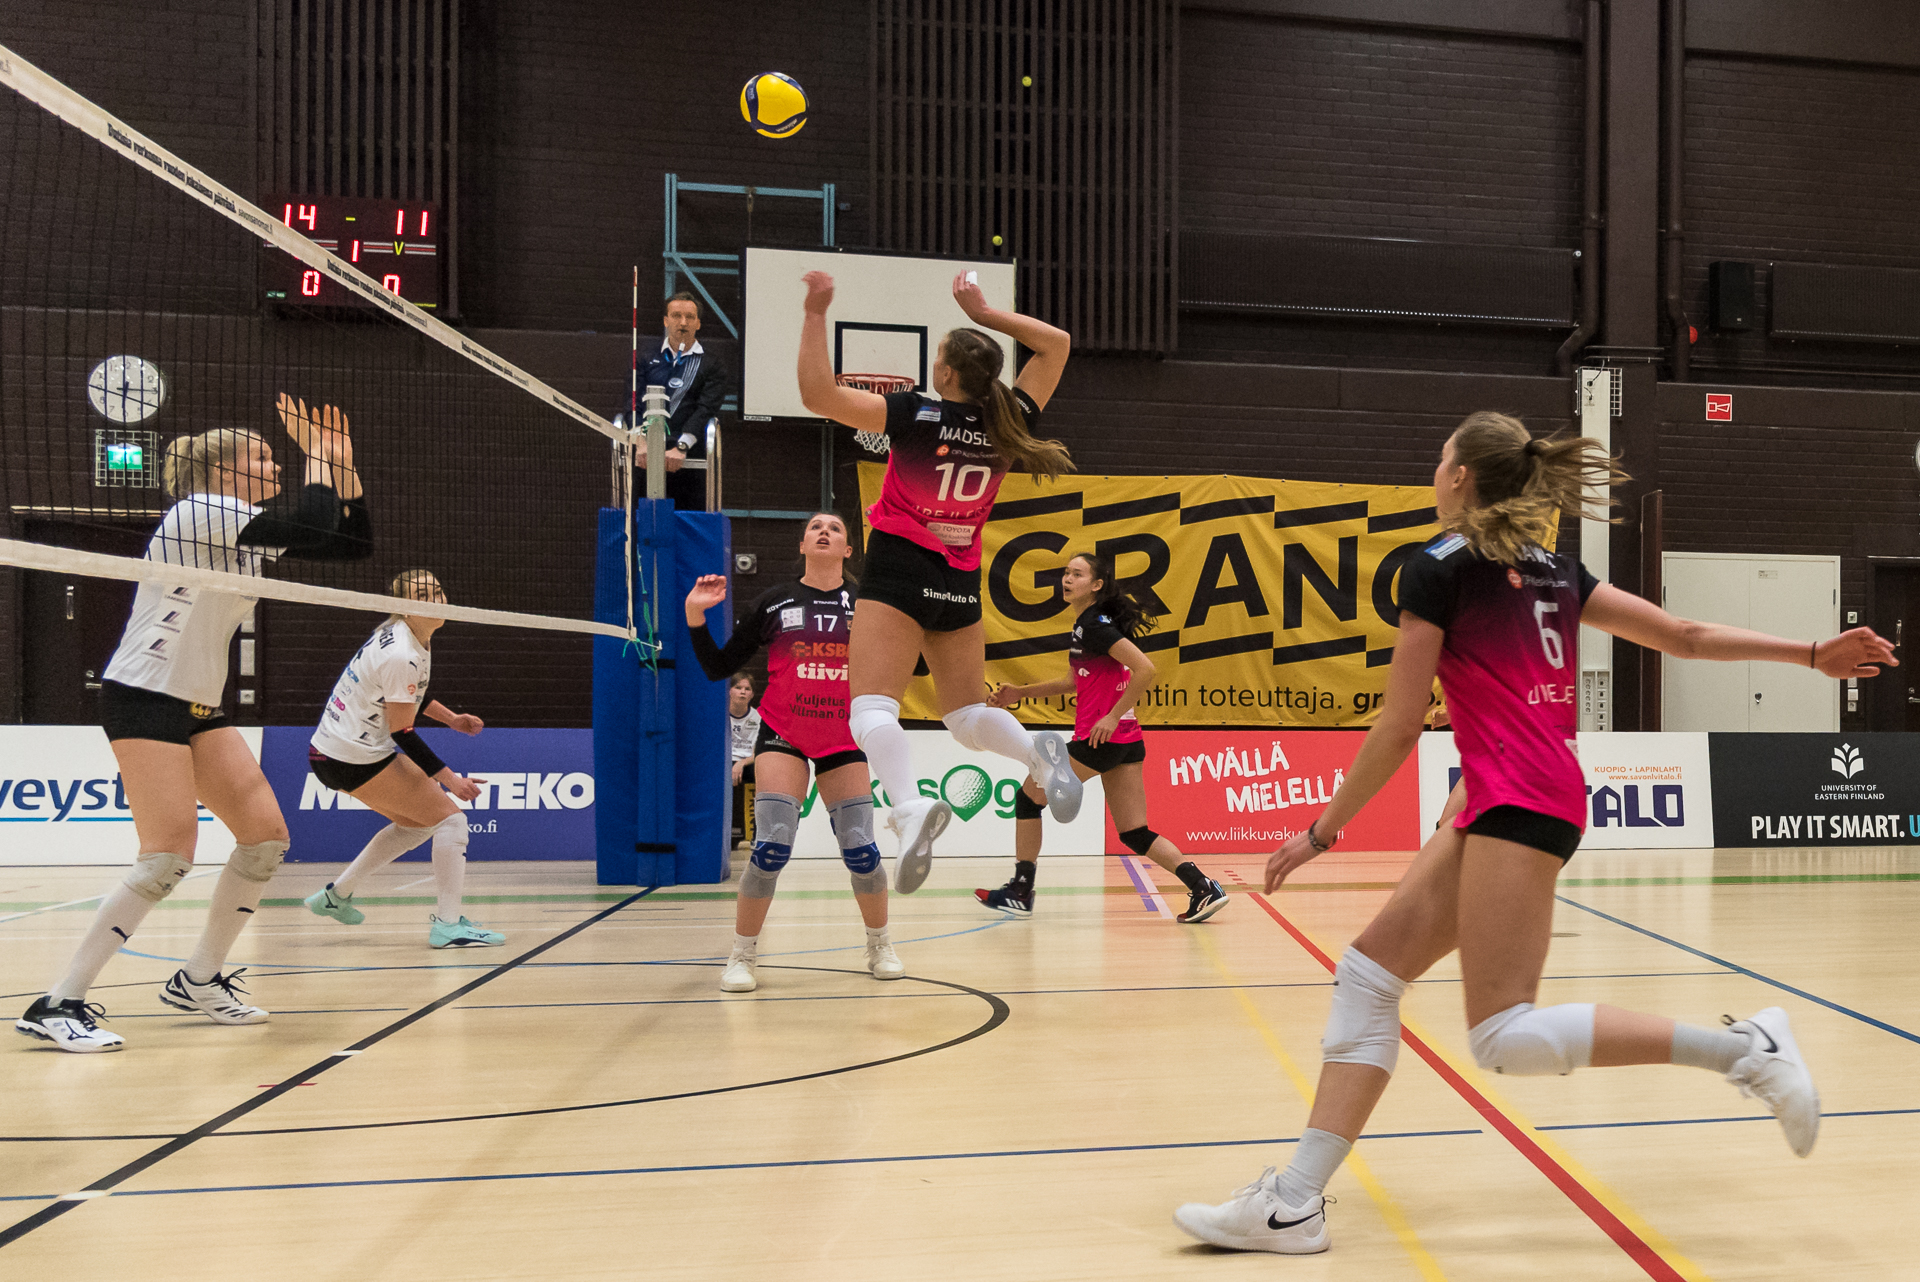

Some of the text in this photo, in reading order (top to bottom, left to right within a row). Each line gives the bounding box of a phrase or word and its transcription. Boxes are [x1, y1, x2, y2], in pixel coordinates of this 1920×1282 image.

[284, 204, 316, 231] 14
[302, 271, 320, 296] 0
[935, 462, 991, 502] 10
[943, 525, 971, 534] TOYOTA
[813, 614, 838, 632] 17
[1533, 600, 1564, 670] 6
[795, 692, 846, 708] Kuljetus
[1198, 683, 1343, 714] toteuttaja.
[1169, 740, 1290, 786] HYVÄLLÄ
[1821, 784, 1866, 792] UNIVERSITY
[1751, 815, 1803, 839] PLAY
[1806, 815, 1826, 838] IT
[1830, 814, 1905, 839] SMART.
